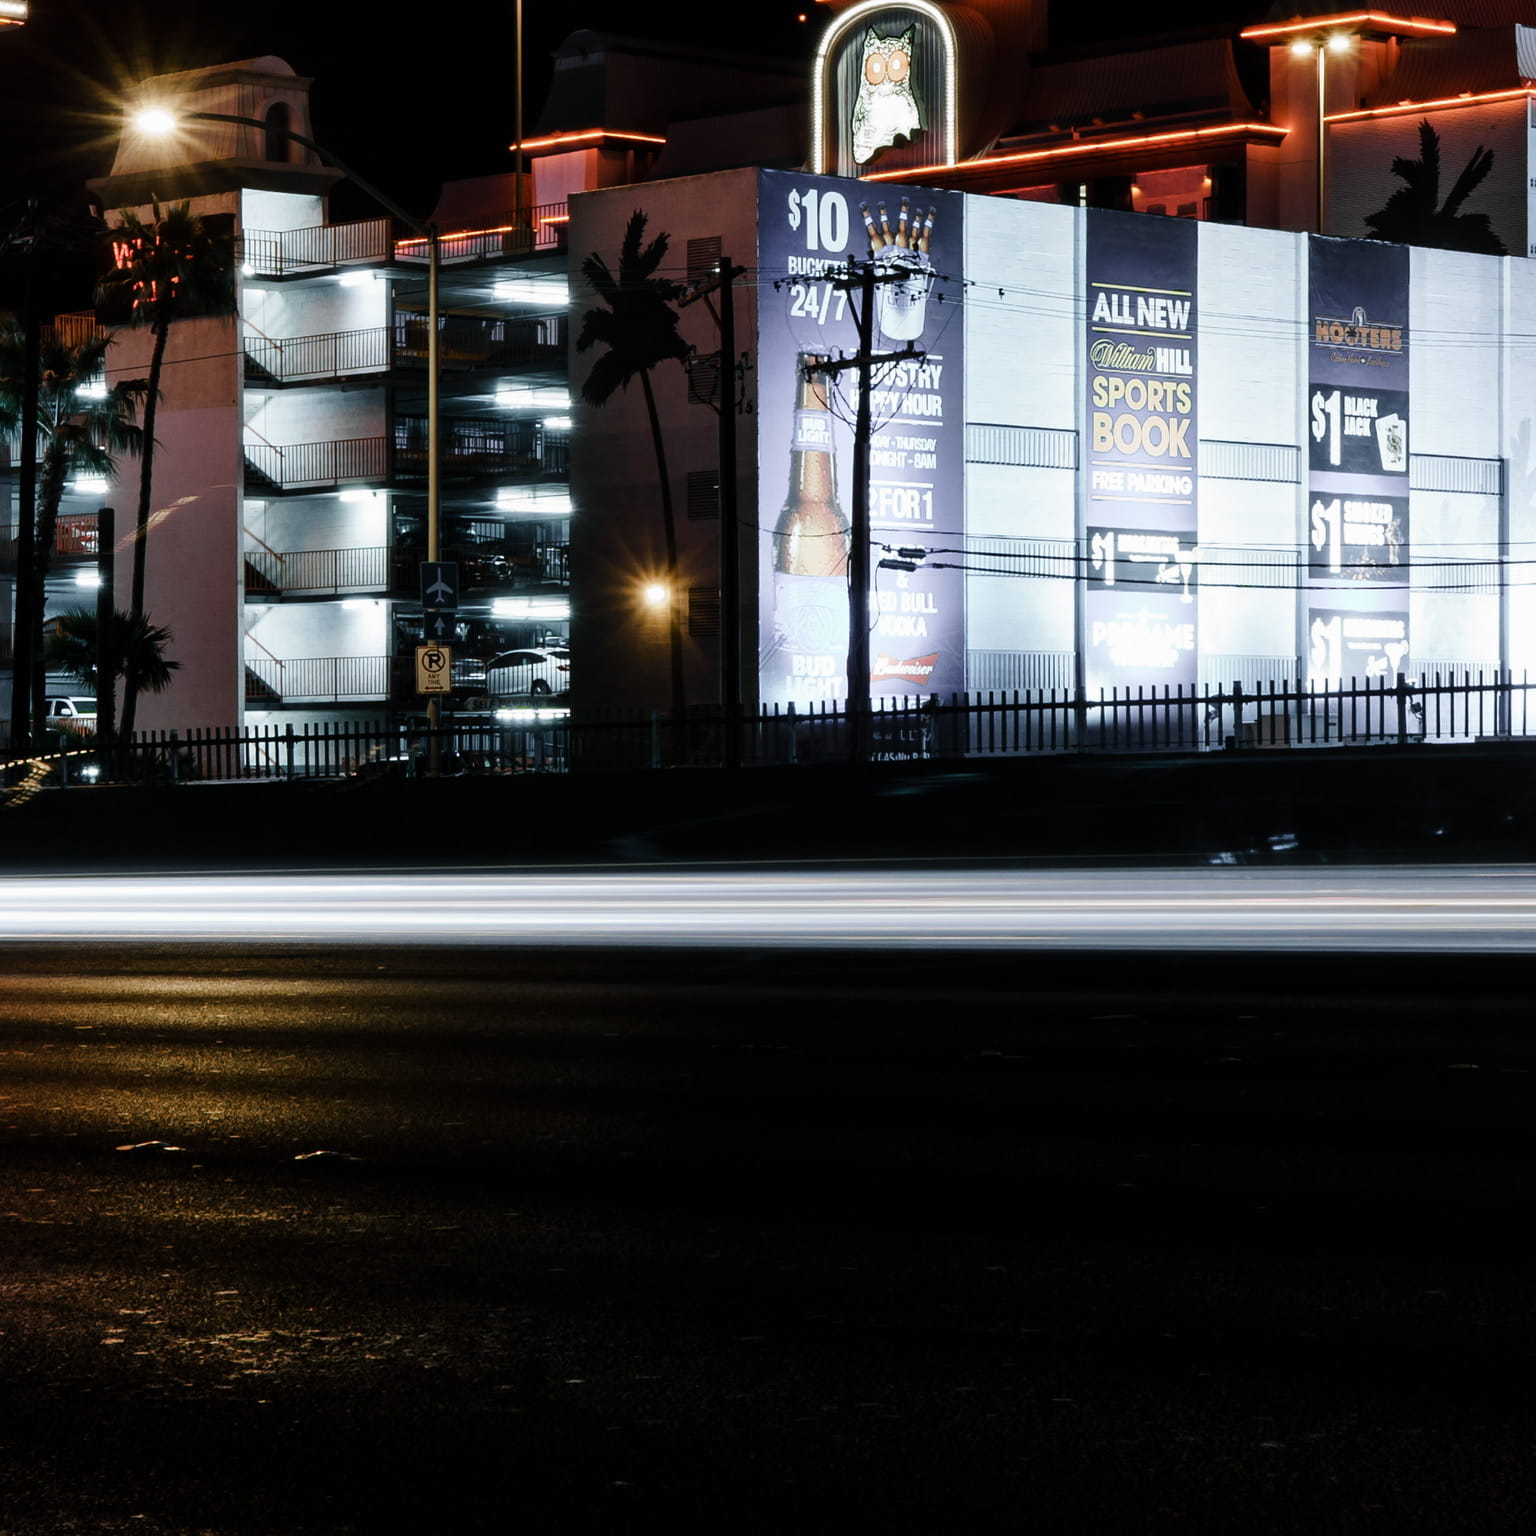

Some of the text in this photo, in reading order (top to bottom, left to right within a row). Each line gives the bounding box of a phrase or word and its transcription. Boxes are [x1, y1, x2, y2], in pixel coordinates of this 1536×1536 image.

[788, 188, 850, 253] $10
[790, 283, 849, 326] 24/7
[1092, 292, 1191, 331] ALL NEW
[1316, 320, 1402, 351] HOOTERS
[1090, 339, 1193, 375] William HILL
[850, 360, 943, 389] IDUSTRY
[850, 389, 942, 417] HPPY HOUR
[1092, 375, 1192, 414] SPORTS
[1344, 395, 1378, 418] BLACK
[1093, 412, 1192, 458] BOOK
[1312, 390, 1341, 466] $1
[1344, 416, 1372, 437] JACK
[914, 452, 937, 469] 8AM
[1092, 470, 1193, 496] FREE PARKING
[879, 487, 921, 519] FOR
[922, 489, 933, 520] 1
[1312, 499, 1341, 574] $1
[1091, 531, 1115, 586] $1
[873, 656, 934, 676] Budweiser
